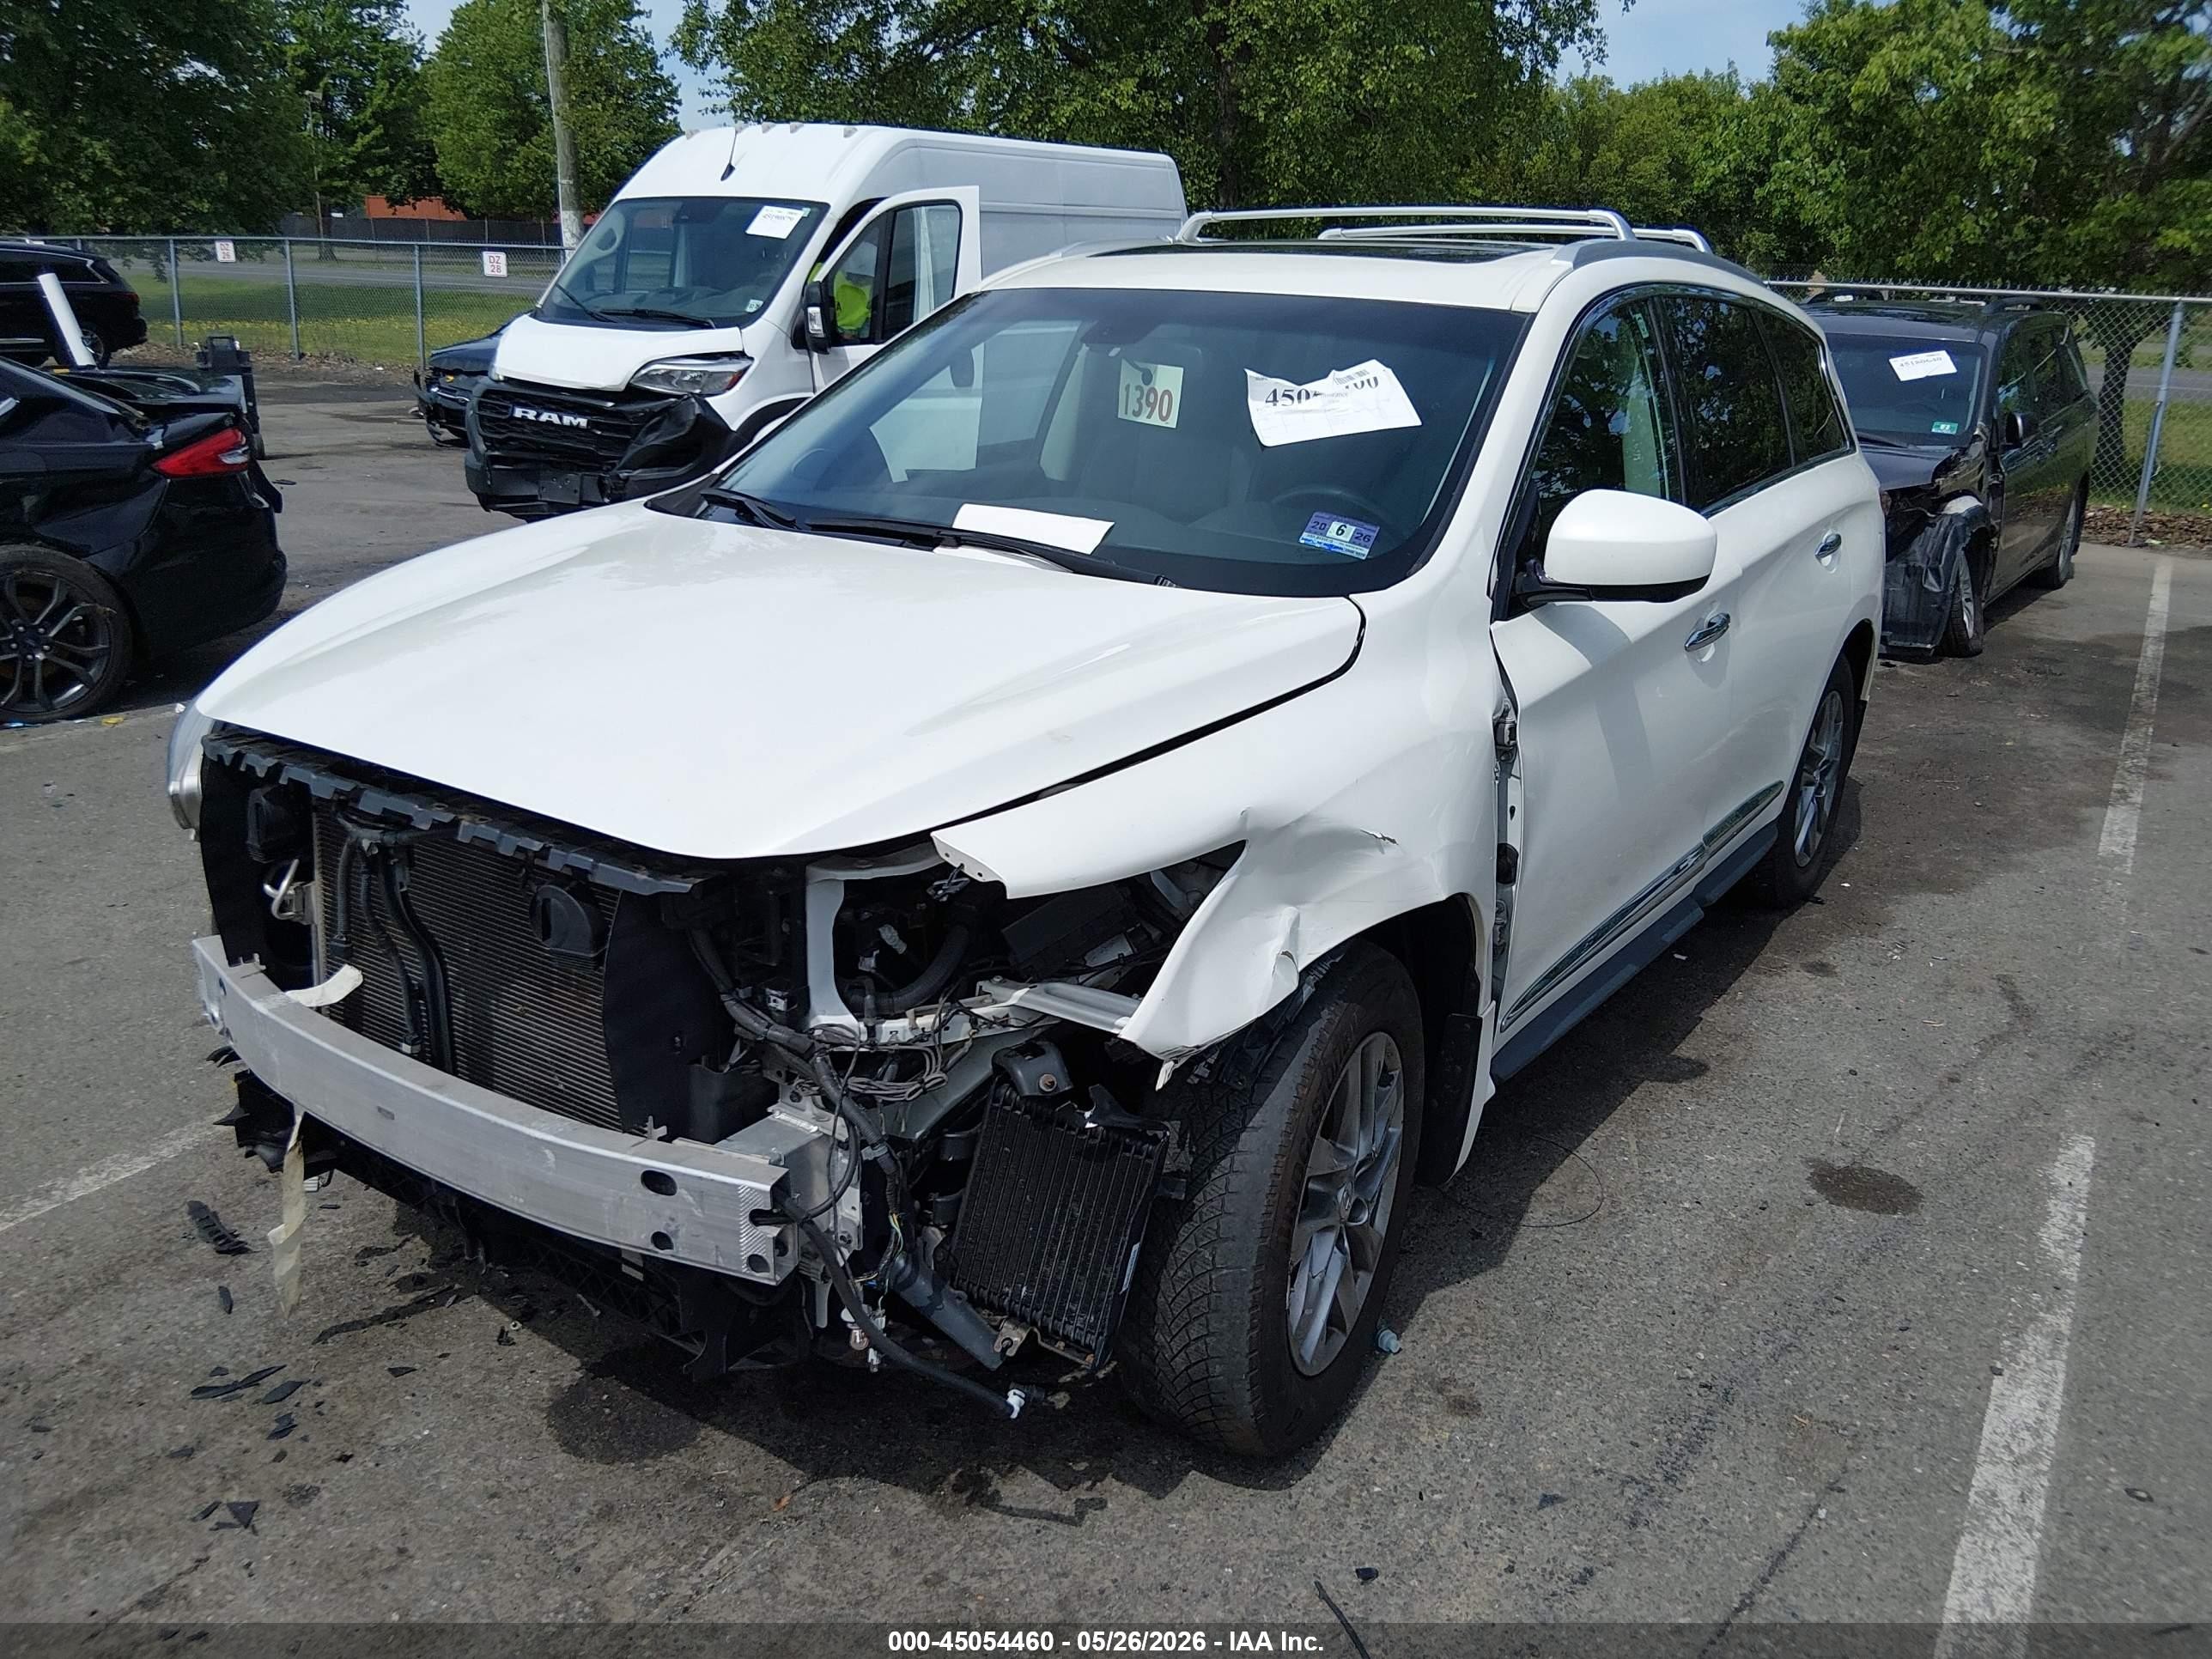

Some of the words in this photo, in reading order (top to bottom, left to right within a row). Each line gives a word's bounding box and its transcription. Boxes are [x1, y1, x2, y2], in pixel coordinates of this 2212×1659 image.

[489, 255, 501, 264] DZ
[490, 264, 502, 273] 28
[1124, 383, 1174, 422] 1390
[513, 407, 589, 428] RAM
[1311, 520, 1328, 531] 20
[1335, 524, 1347, 537] 6
[1354, 532, 1372, 543] 26
